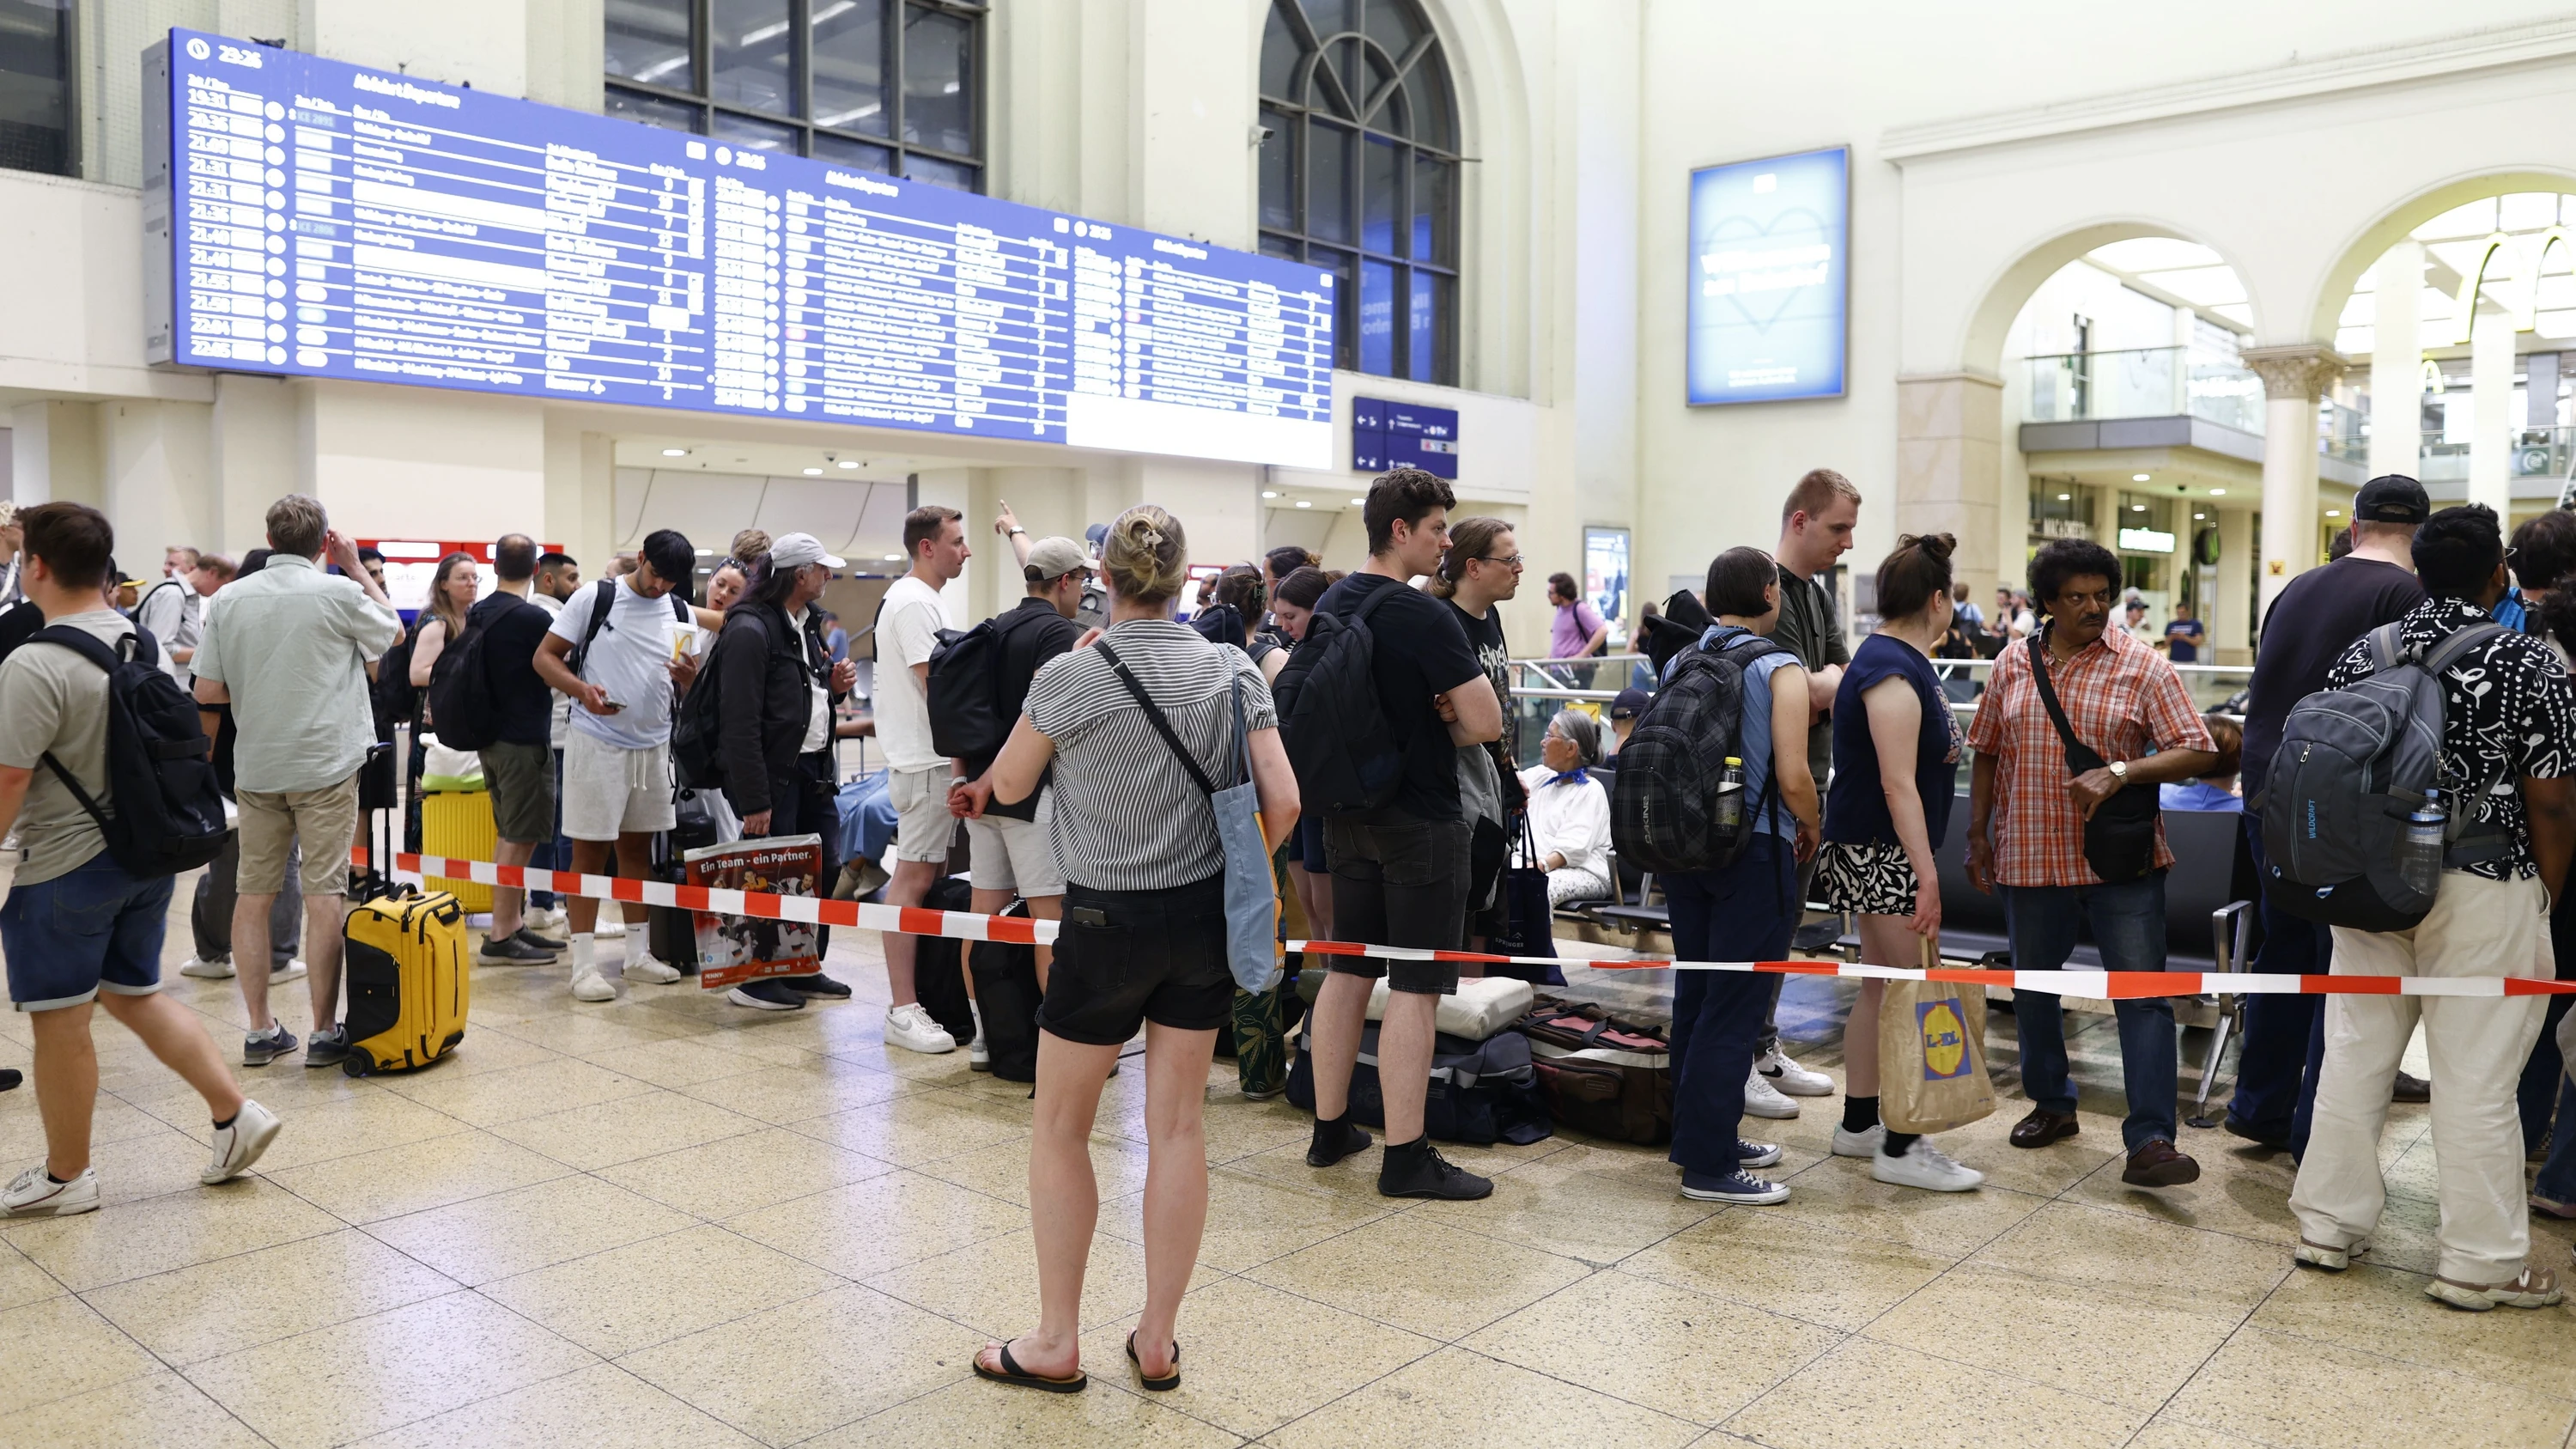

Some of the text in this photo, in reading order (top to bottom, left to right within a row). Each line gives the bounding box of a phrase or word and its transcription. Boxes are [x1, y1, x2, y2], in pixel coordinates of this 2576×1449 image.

[2308, 798, 2317, 839] WILDCRAFT
[701, 861, 715, 873] Ein
[717, 857, 744, 869] Team
[753, 853, 769, 865] ein
[771, 850, 812, 862] Partner.
